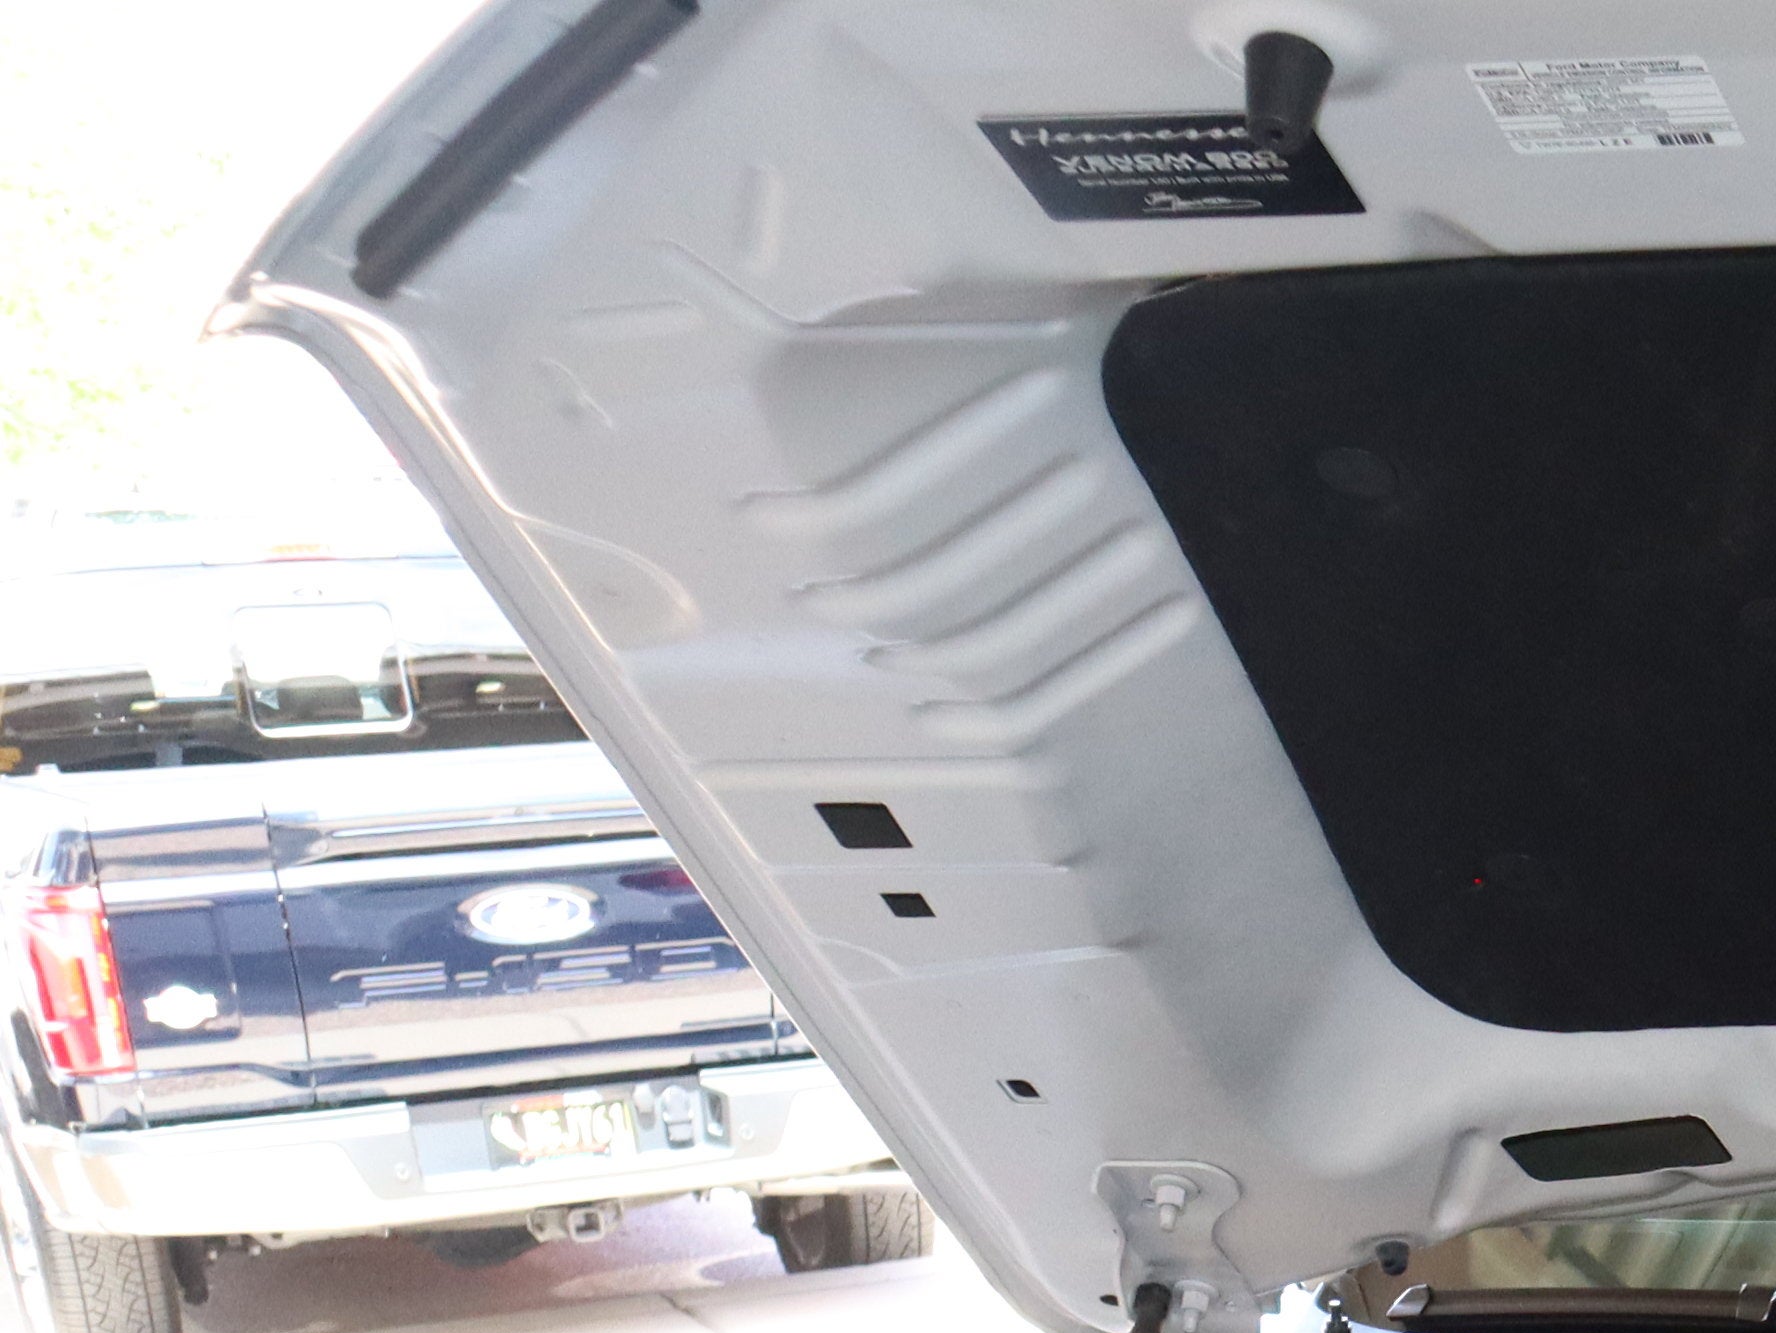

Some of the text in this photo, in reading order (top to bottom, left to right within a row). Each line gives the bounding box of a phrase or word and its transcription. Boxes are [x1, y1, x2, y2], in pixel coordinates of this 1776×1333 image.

[1545, 58, 1681, 71] Ford Motor Company
[1010, 126, 1250, 147] Hennesse
[1050, 152, 1200, 168] VENOM
